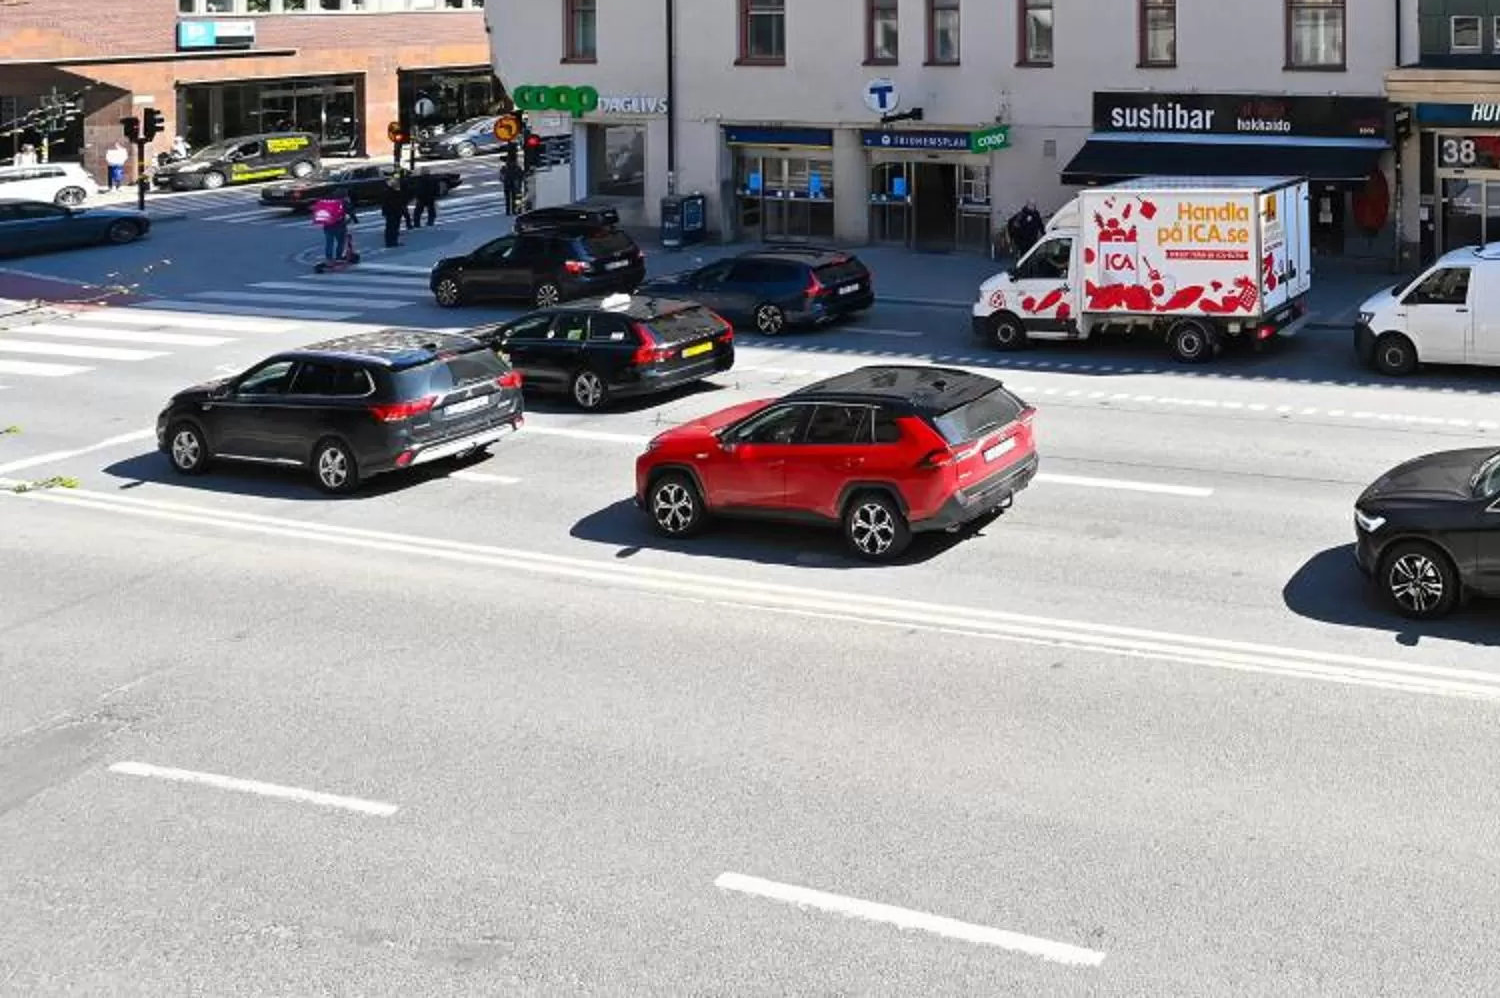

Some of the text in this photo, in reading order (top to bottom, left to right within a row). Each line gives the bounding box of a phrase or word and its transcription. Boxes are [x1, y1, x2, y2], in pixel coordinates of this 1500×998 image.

[513, 85, 599, 118] coop
[869, 85, 893, 108] T
[1111, 103, 1215, 130] sushibar
[1237, 118, 1291, 133] hokkaido
[1443, 139, 1475, 164] 38
[1178, 202, 1249, 222] Handla
[1157, 227, 1184, 247] på
[1187, 224, 1249, 244] ICA.se
[1104, 253, 1136, 271] ICA
